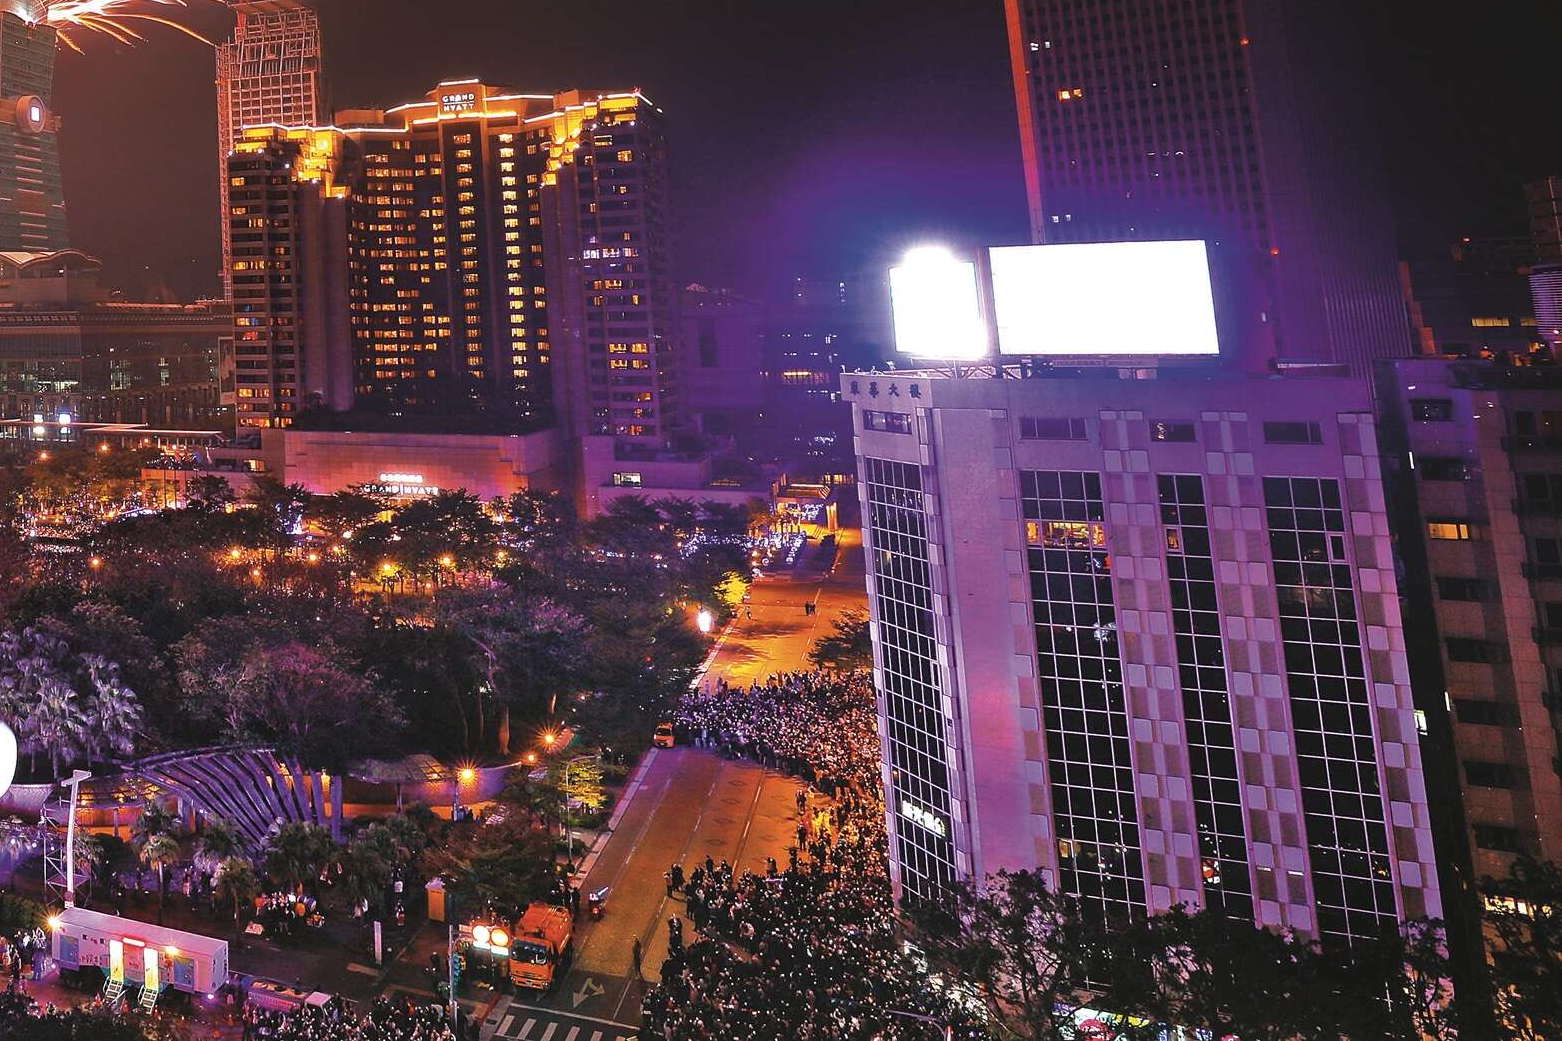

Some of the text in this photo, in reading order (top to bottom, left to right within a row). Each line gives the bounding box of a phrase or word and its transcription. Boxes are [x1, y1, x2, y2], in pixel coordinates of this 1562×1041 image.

[442, 93, 475, 103] GRAND
[443, 103, 475, 112] HYATT
[364, 484, 439, 496] GRAND HYATT
